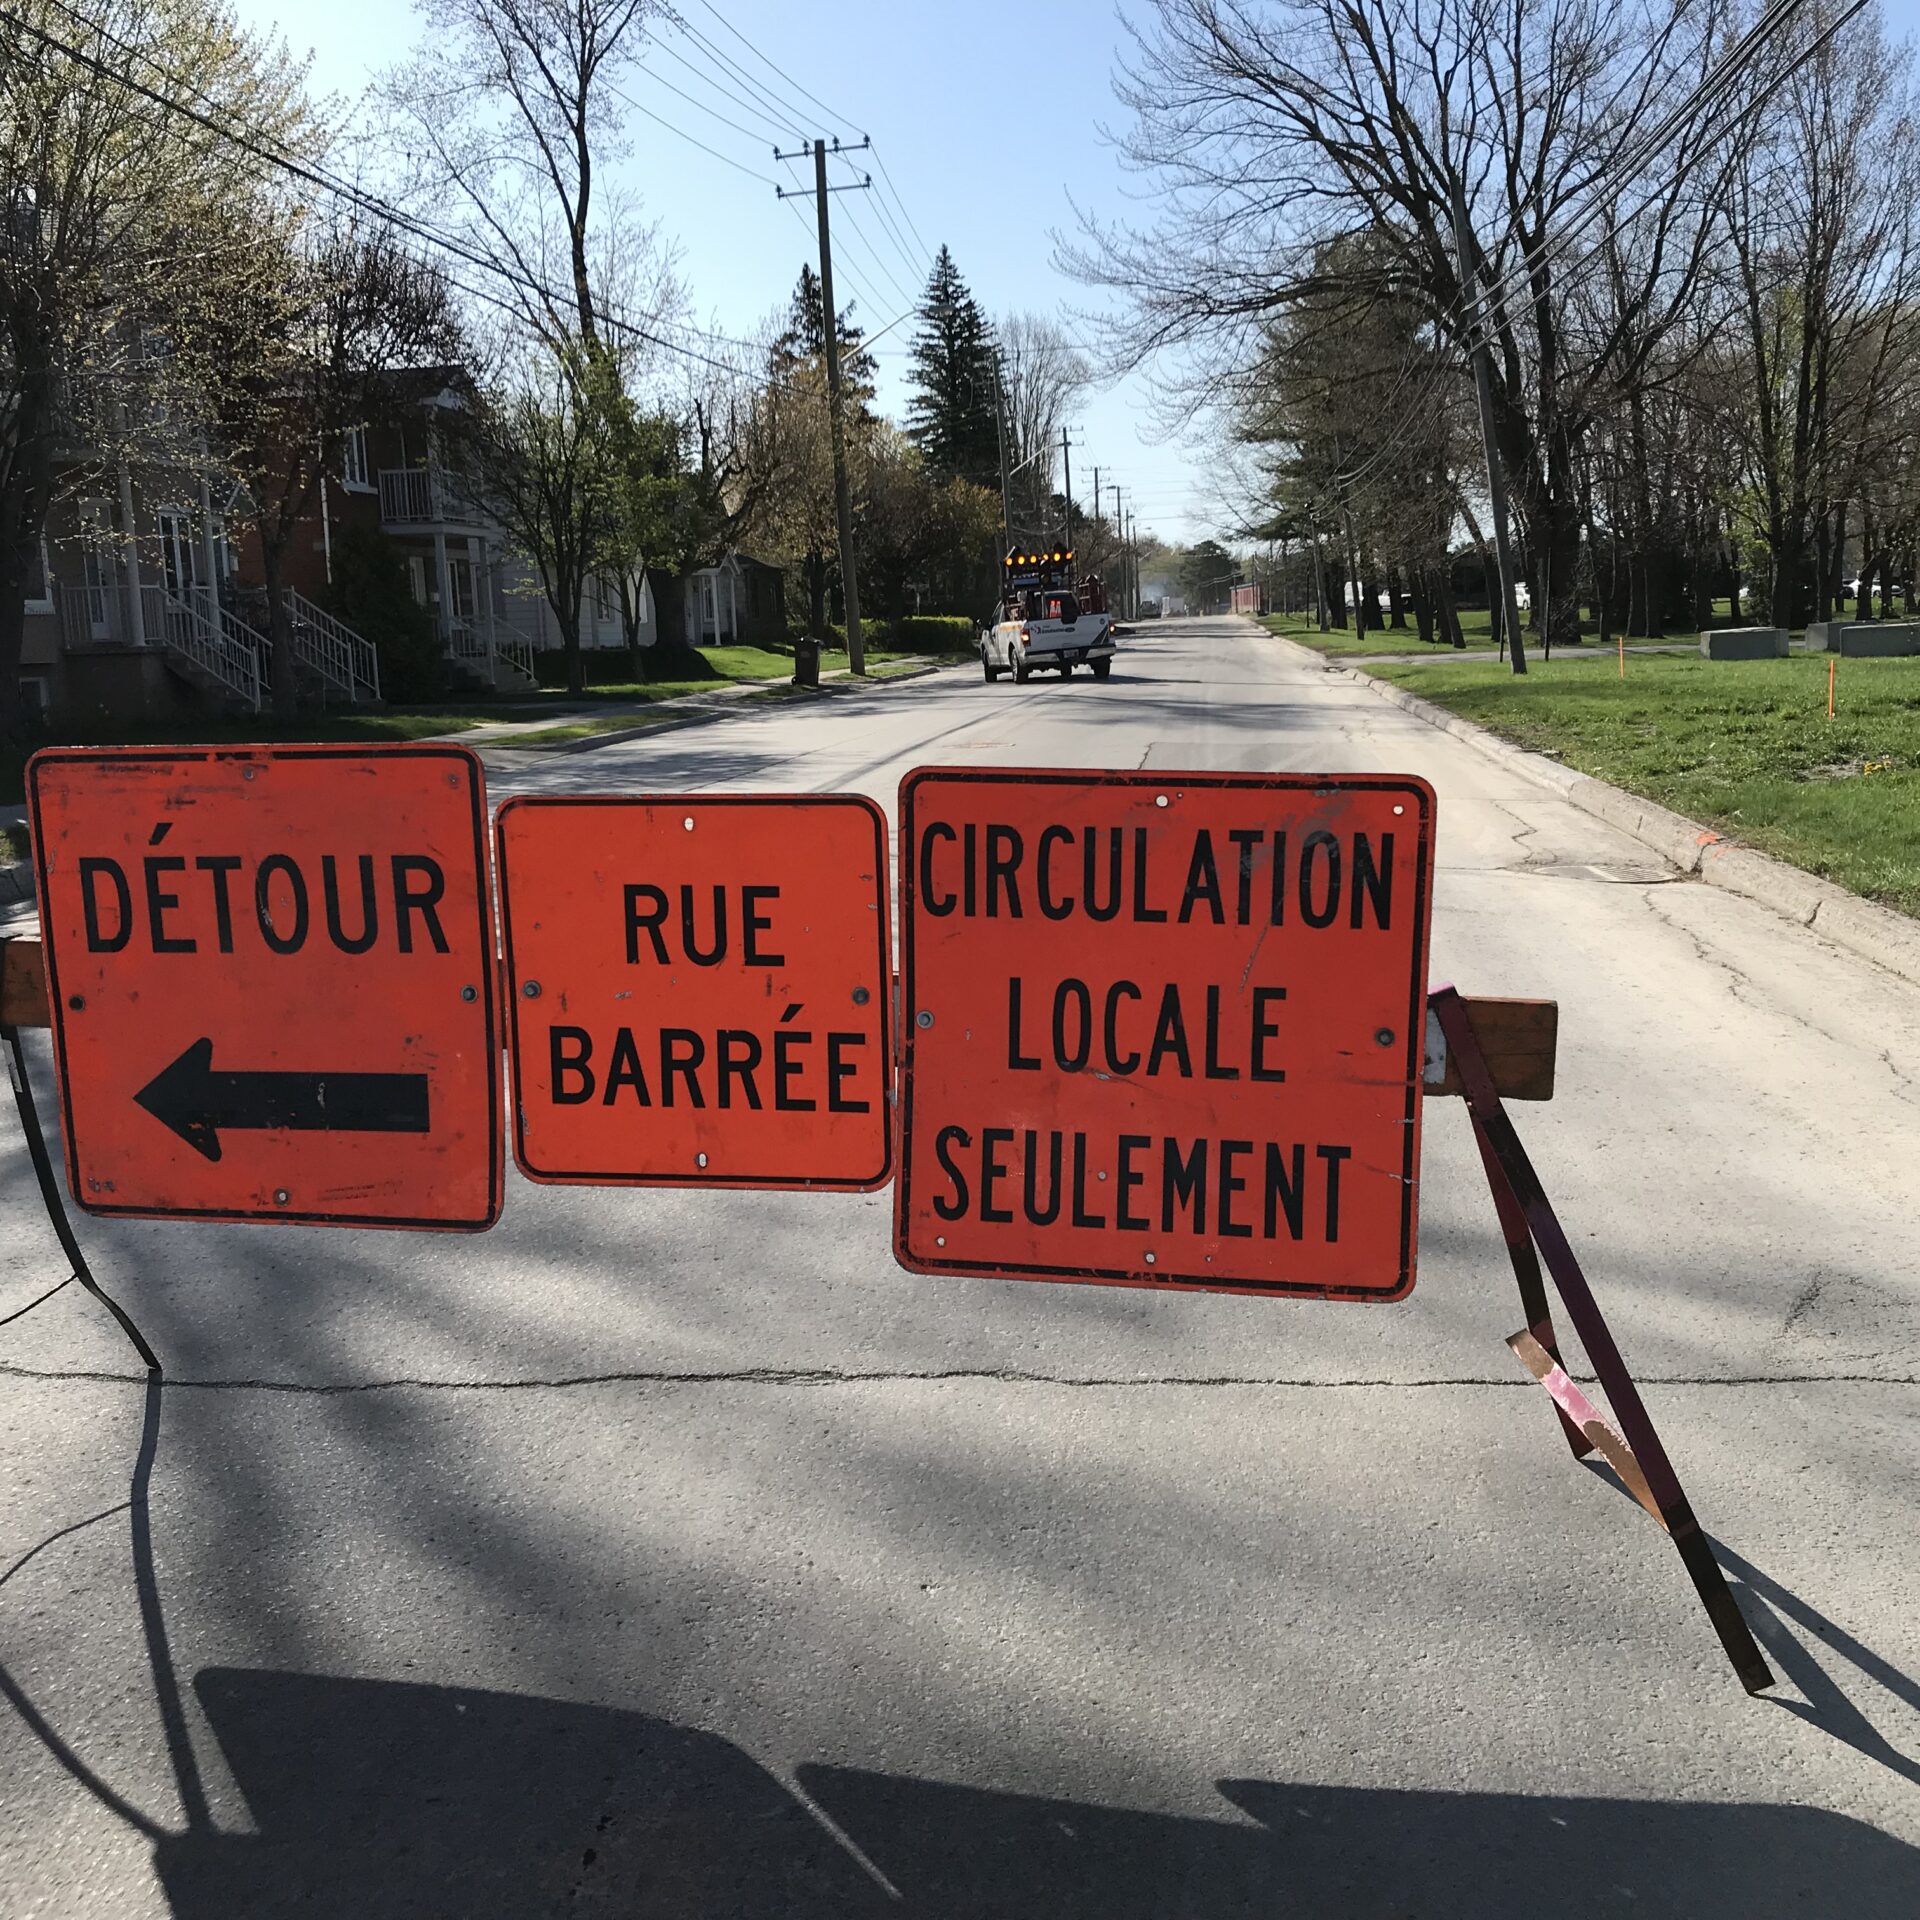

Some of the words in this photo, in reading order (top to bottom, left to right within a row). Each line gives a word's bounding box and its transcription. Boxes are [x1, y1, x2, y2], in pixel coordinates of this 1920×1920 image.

[79, 822, 451, 955] DÉTOUR
[623, 884, 785, 967] RUE
[919, 821, 1394, 930] CIRCULATION
[549, 1003, 870, 1114] BARRÉE
[1008, 976, 1287, 1083] LOCALE
[932, 1125, 1352, 1242] SEULEMENT
